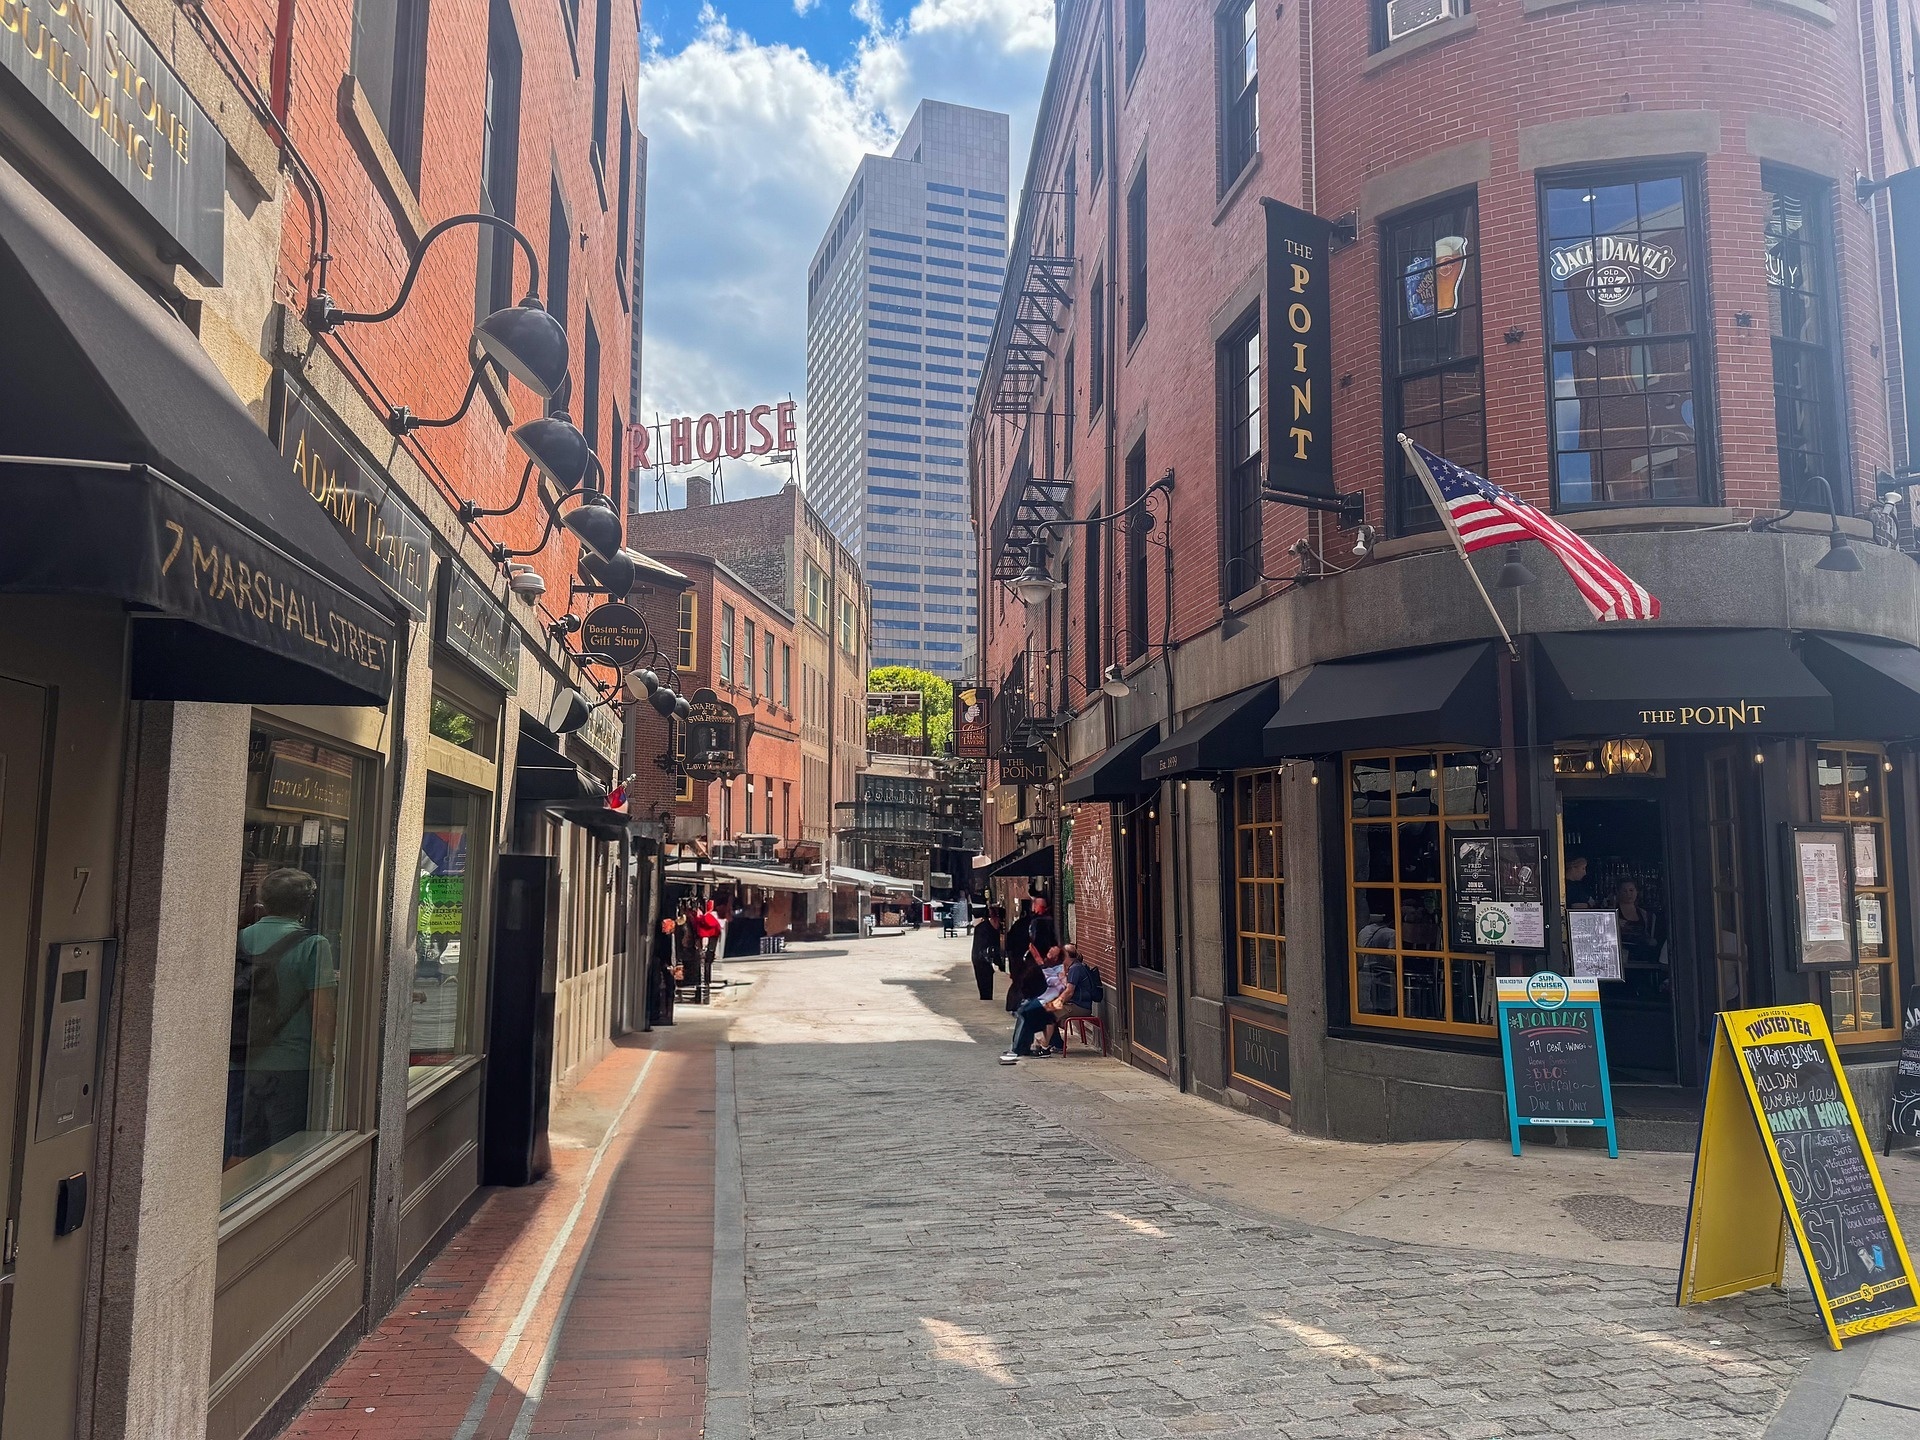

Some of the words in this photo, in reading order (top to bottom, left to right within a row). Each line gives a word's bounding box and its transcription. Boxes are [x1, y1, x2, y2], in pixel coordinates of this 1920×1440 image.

[104, 29, 189, 165] STONE
[1284, 238, 1314, 261] THE
[1555, 244, 1599, 276] JACK
[1595, 236, 1672, 275] DANIEL'S
[1288, 263, 1313, 461] POINT
[670, 401, 798, 467] HOUSE
[293, 429, 357, 536] ADAM
[363, 496, 423, 593] TRAVEL
[162, 520, 184, 577] 7
[191, 536, 328, 648] MARSHALL
[328, 609, 388, 672] STREET
[587, 624, 618, 634] Boston
[621, 625, 644, 635] Stone
[590, 634, 611, 646] Gift
[614, 635, 640, 648] Shop
[1638, 710, 1677, 724] THE
[1679, 699, 1766, 731] POINT
[1001, 763, 1045, 780] POINT
[1006, 758, 1025, 766] THE
[73, 866, 91, 915] 7
[1517, 1011, 1588, 1029] MONDAYS
[1745, 1016, 1790, 1042] TWISTED
[1790, 1017, 1813, 1037] TEA
[1248, 1026, 1263, 1043] THE
[1244, 1040, 1280, 1072] POINT
[1529, 1039, 1542, 1054] 99
[1532, 1066, 1562, 1079] BBQ
[1756, 1074, 1777, 1093] ALL
[1775, 1072, 1798, 1090] DAY
[1808, 1080, 1837, 1103] day
[1766, 1106, 1813, 1133] HAPPY
[1814, 1100, 1852, 1128] HOUR
[1817, 1133, 1839, 1147] GREEN
[1836, 1129, 1852, 1143] TEA
[1832, 1145, 1853, 1157] SHOTS
[1774, 1133, 1834, 1205] $6
[1844, 1203, 1865, 1216] SWEET
[1863, 1199, 1878, 1211] TEA
[1843, 1217, 1862, 1230] VODKA
[1800, 1204, 1850, 1282] $7
[1851, 1235, 1865, 1248] GIN
[1868, 1229, 1888, 1240] JUICE
